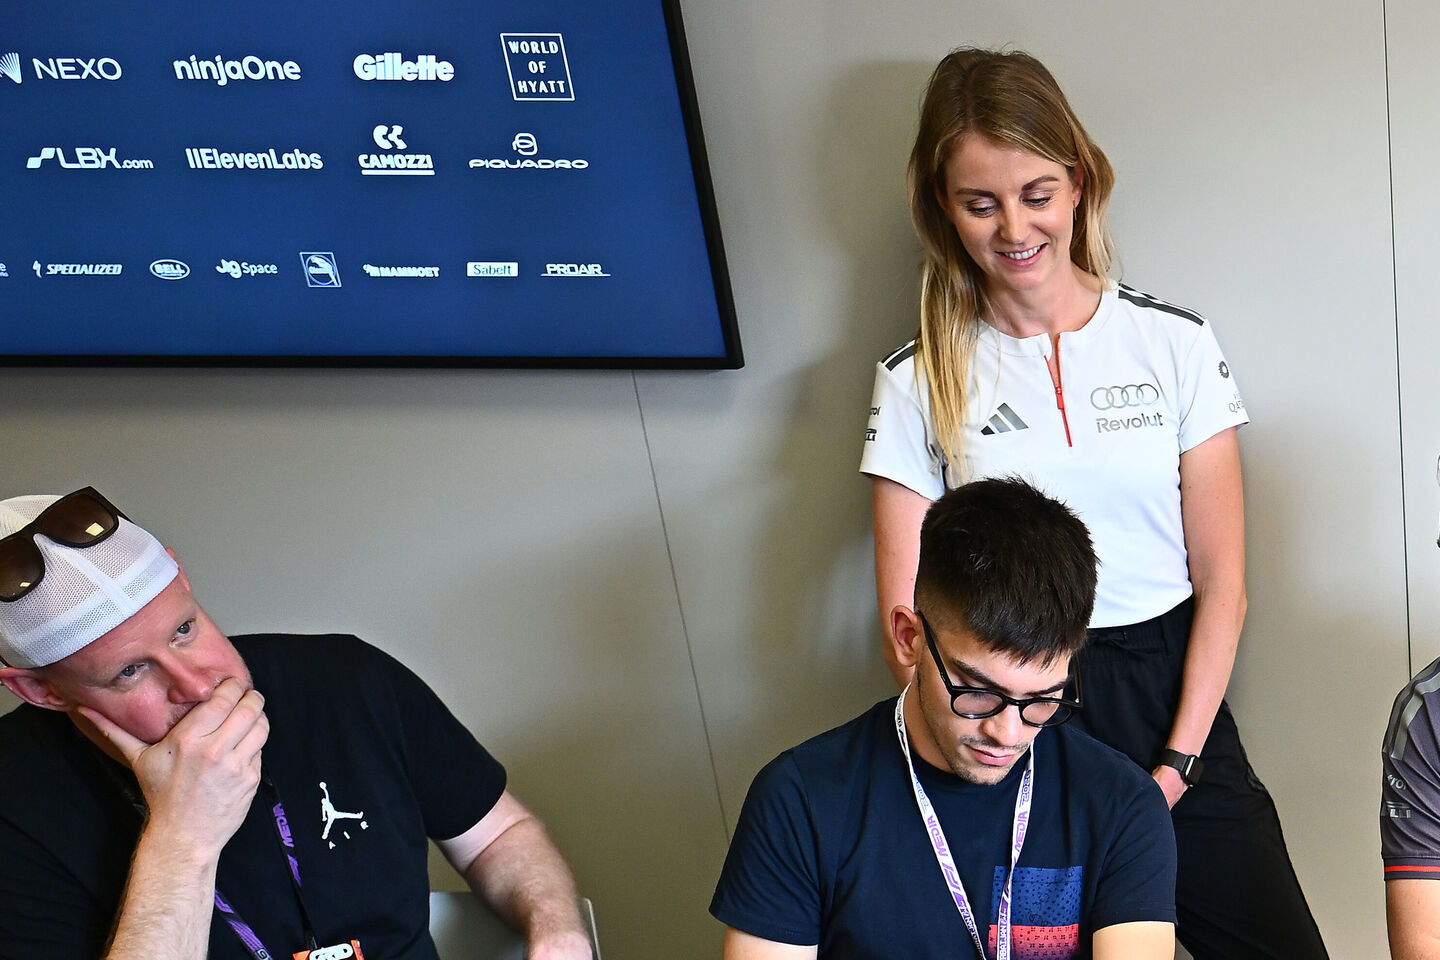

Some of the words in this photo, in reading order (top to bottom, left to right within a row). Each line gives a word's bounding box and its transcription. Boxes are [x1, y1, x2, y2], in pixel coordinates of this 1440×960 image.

[508, 41, 559, 54] WORLD
[32, 57, 123, 81] NEXO
[173, 54, 302, 86] ninjaOne
[353, 52, 455, 82] Gillette
[528, 61, 547, 74] OF
[517, 80, 566, 94] HYATT
[358, 153, 434, 170] CAMOZZI
[469, 158, 589, 170] PIQUADRO
[46, 263, 123, 276] SPECIALIZED
[154, 263, 186, 275] BELL
[473, 264, 512, 276] Sabelt
[1096, 411, 1163, 434] Revolut
[928, 814, 948, 857] MEDIA
[1014, 810, 1029, 853] MEDIA
